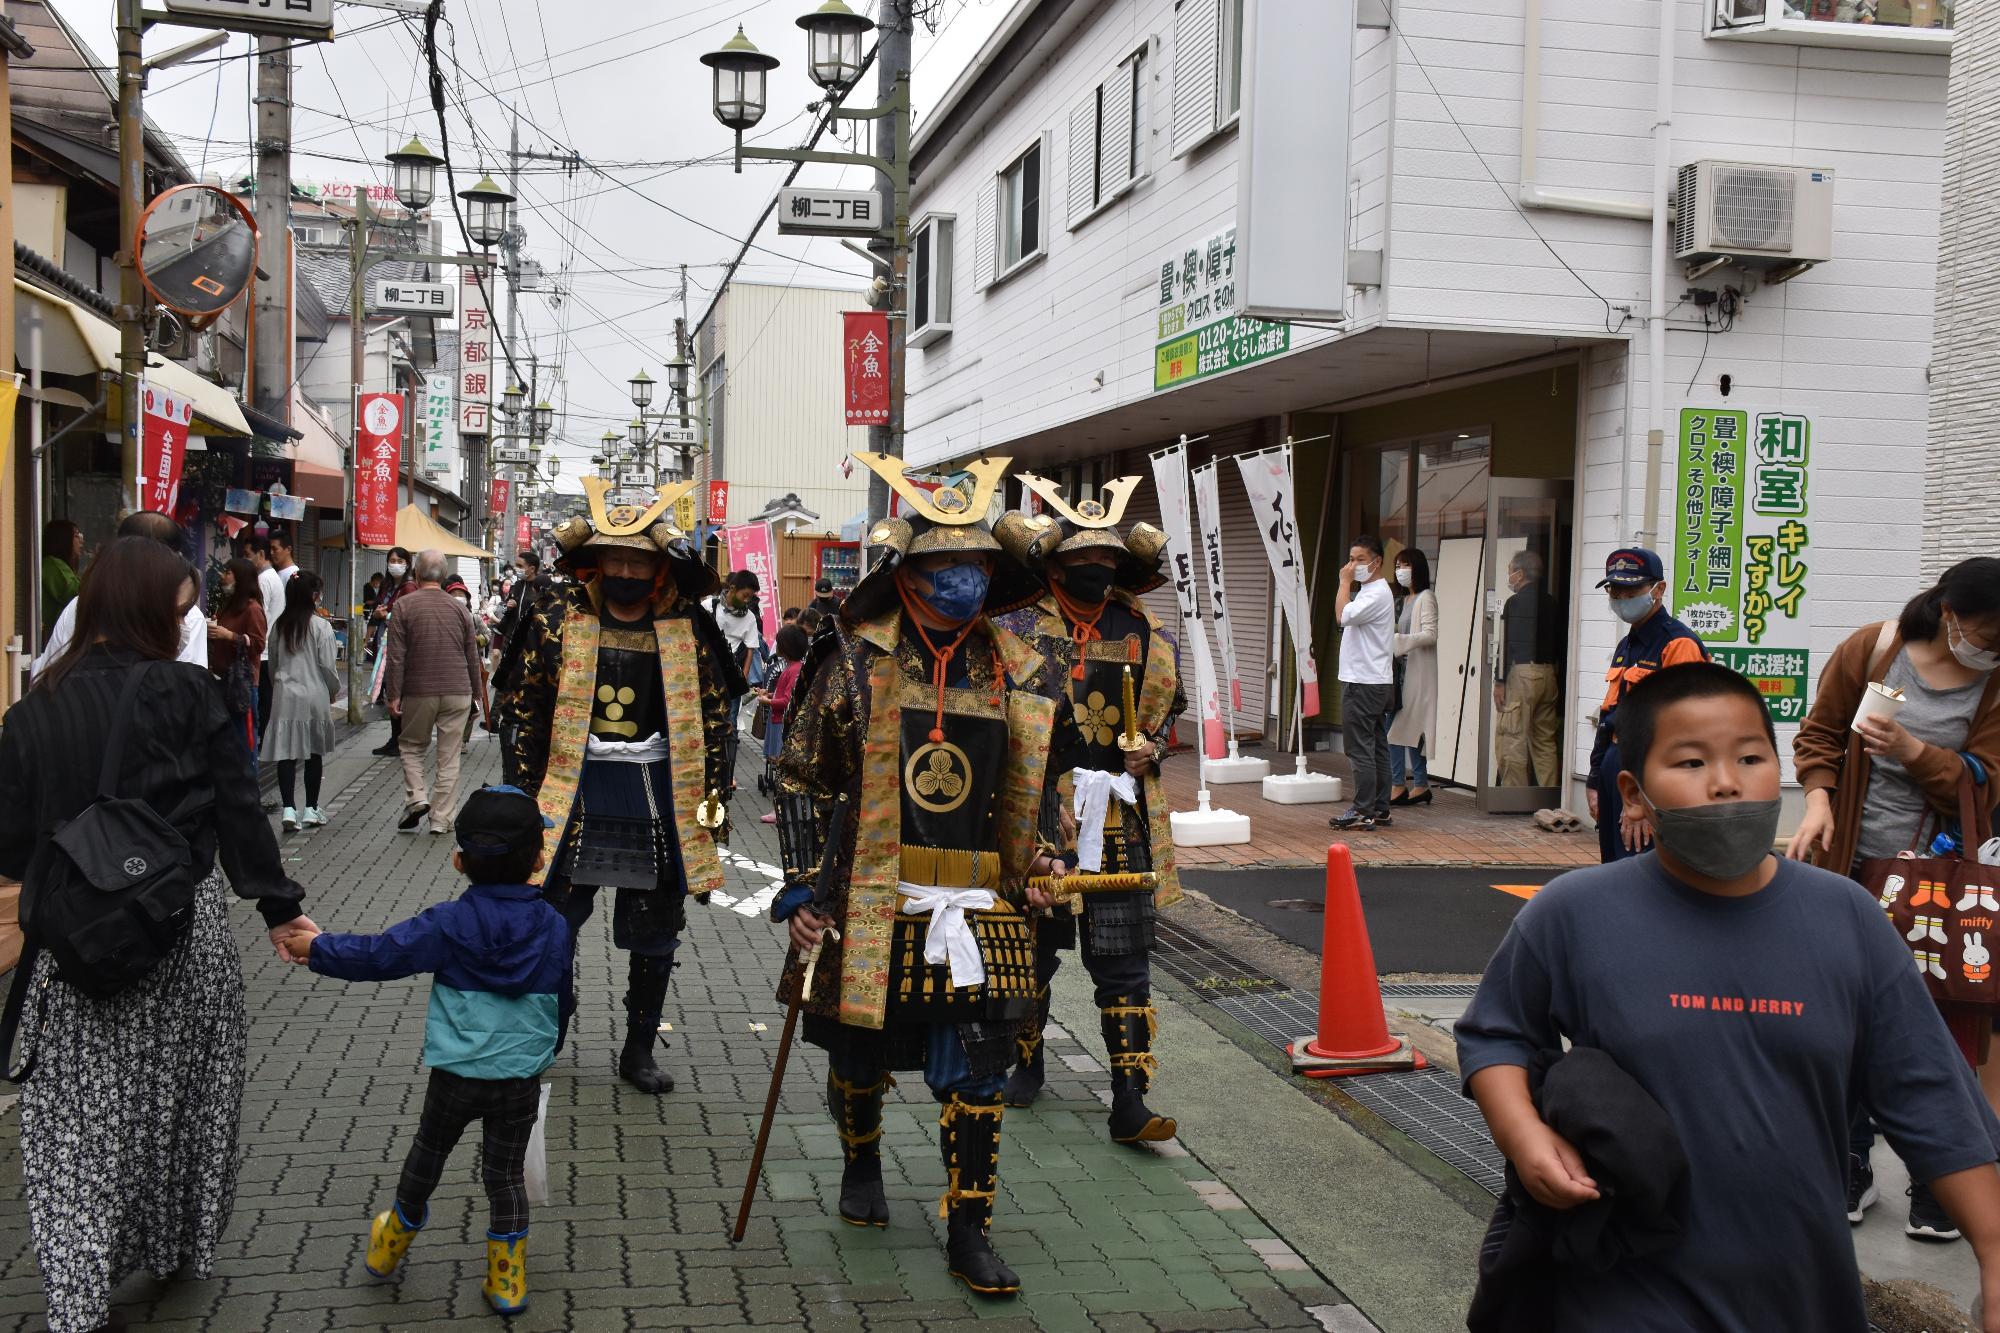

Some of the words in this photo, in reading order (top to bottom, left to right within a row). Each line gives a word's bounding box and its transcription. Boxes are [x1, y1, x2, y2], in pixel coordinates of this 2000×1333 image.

[791, 196, 869, 220] 柳二丁目
[384, 287, 443, 304] 柳二丁目
[1187, 294, 1211, 325] クロス
[464, 308, 489, 427] 京都銀行
[849, 339, 860, 404] ストリート
[860, 330, 884, 379] 金魚
[1199, 346, 1230, 374] 株式会社
[1233, 327, 1286, 362] くらし応援社
[428, 395, 444, 452] クリエイト
[1688, 415, 1707, 463] クロス
[1758, 417, 1803, 509] 和室
[1706, 416, 1738, 594] 畳・襖・障子・網戸
[1683, 468, 1706, 593] その他リフォーム
[1776, 523, 1805, 615] キレイ
[1686, 609, 1727, 620] 1枚からでも
[1690, 619, 1720, 629] 承ります
[1960, 917, 1993, 930] miffy
[1669, 993, 1706, 1009] TOM
[1711, 996, 1744, 1012] AND
[1749, 998, 1804, 1016] JERRY
